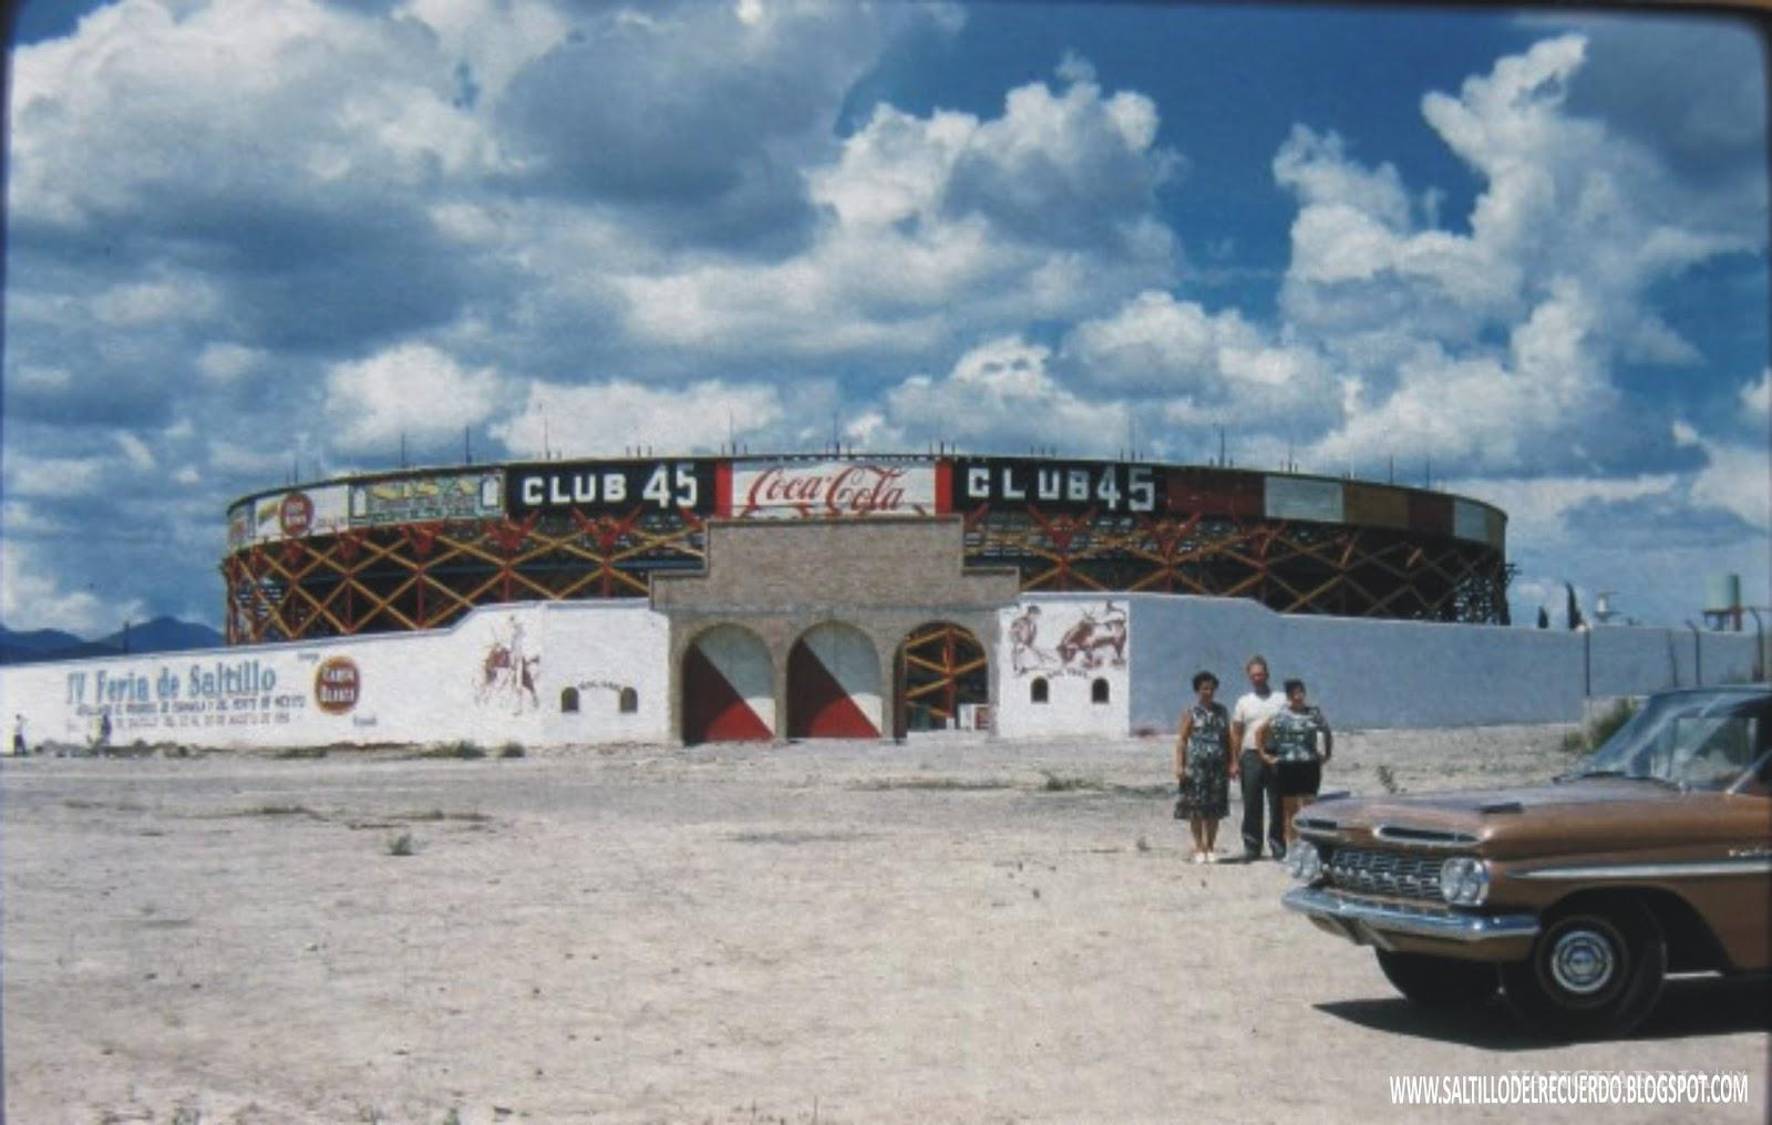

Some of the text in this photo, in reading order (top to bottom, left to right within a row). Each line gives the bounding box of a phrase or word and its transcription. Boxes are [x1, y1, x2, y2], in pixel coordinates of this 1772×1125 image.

[522, 473, 627, 506] CLUB
[642, 463, 698, 509] 45
[747, 464, 906, 512] Coca-Cola
[967, 465, 1155, 512] CLUB 45
[96, 669, 150, 703] Feria
[157, 667, 180, 700] de
[189, 659, 277, 699] Saltillo
